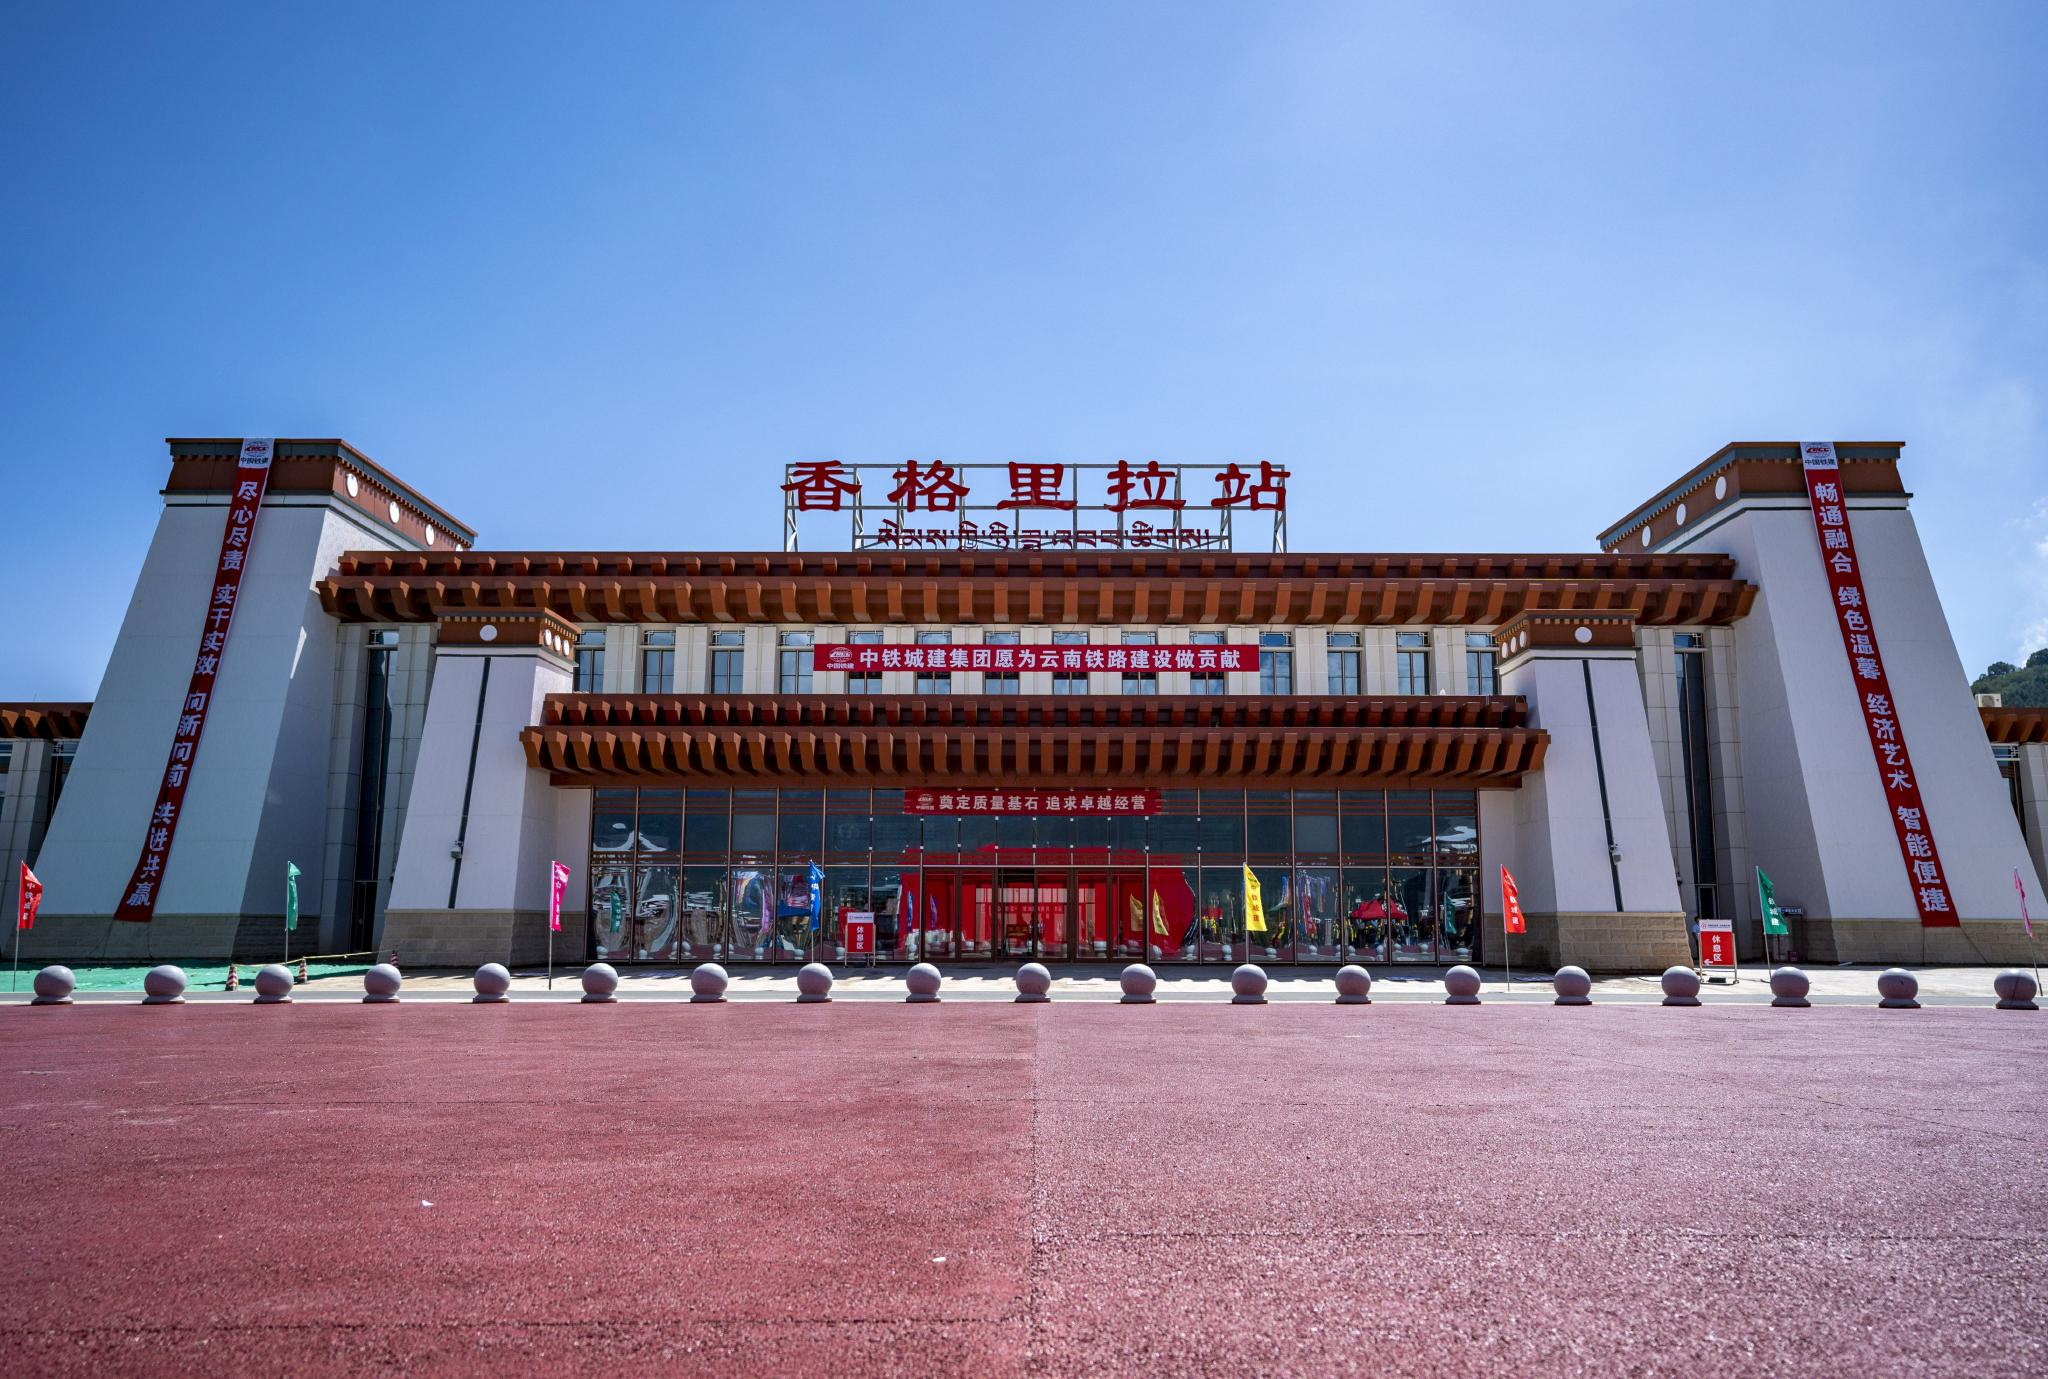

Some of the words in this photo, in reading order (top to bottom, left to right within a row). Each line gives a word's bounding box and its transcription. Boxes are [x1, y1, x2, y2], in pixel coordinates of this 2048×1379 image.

[781, 459, 1291, 512] 香格里拉站
[222, 481, 258, 571] 尽心尽责
[195, 583, 237, 675] 实干实效
[860, 648, 1241, 670] 中铁城建集团愿为云南铁路建设做贡献
[1814, 482, 1852, 574] 畅通融合
[1838, 586, 1880, 680] 绿色温馨
[1866, 692, 1912, 791] 经济艺术
[1897, 806, 1949, 912] 智能便捷
[168, 690, 207, 788] 向新向前
[938, 795, 1039, 811] 奠定质量基石
[1046, 795, 1146, 811] 追求卓越经营
[856, 926, 864, 950] 休息区
[1712, 935, 1722, 962] 休息区
